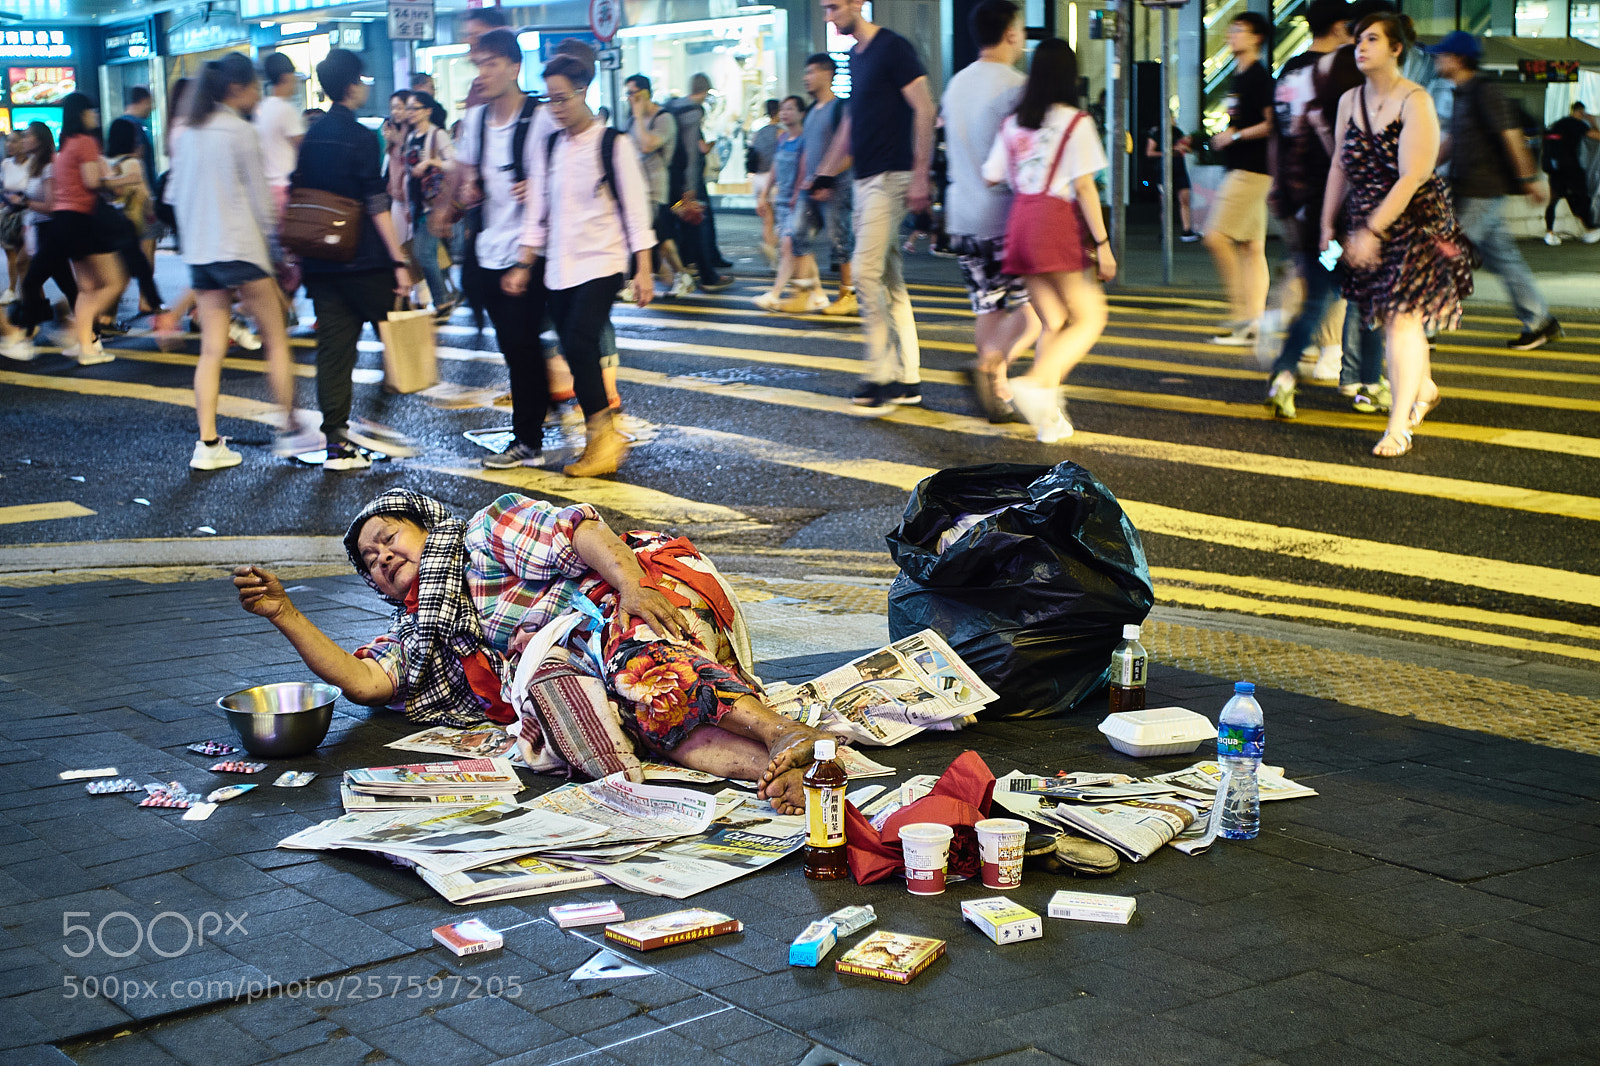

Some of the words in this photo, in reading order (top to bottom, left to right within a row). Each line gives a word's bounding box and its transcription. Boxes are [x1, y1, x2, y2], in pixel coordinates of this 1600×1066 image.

[838, 964, 851, 972] PAIN
[851, 965, 879, 977] RELIEVING
[879, 972, 904, 982] PLASTER
